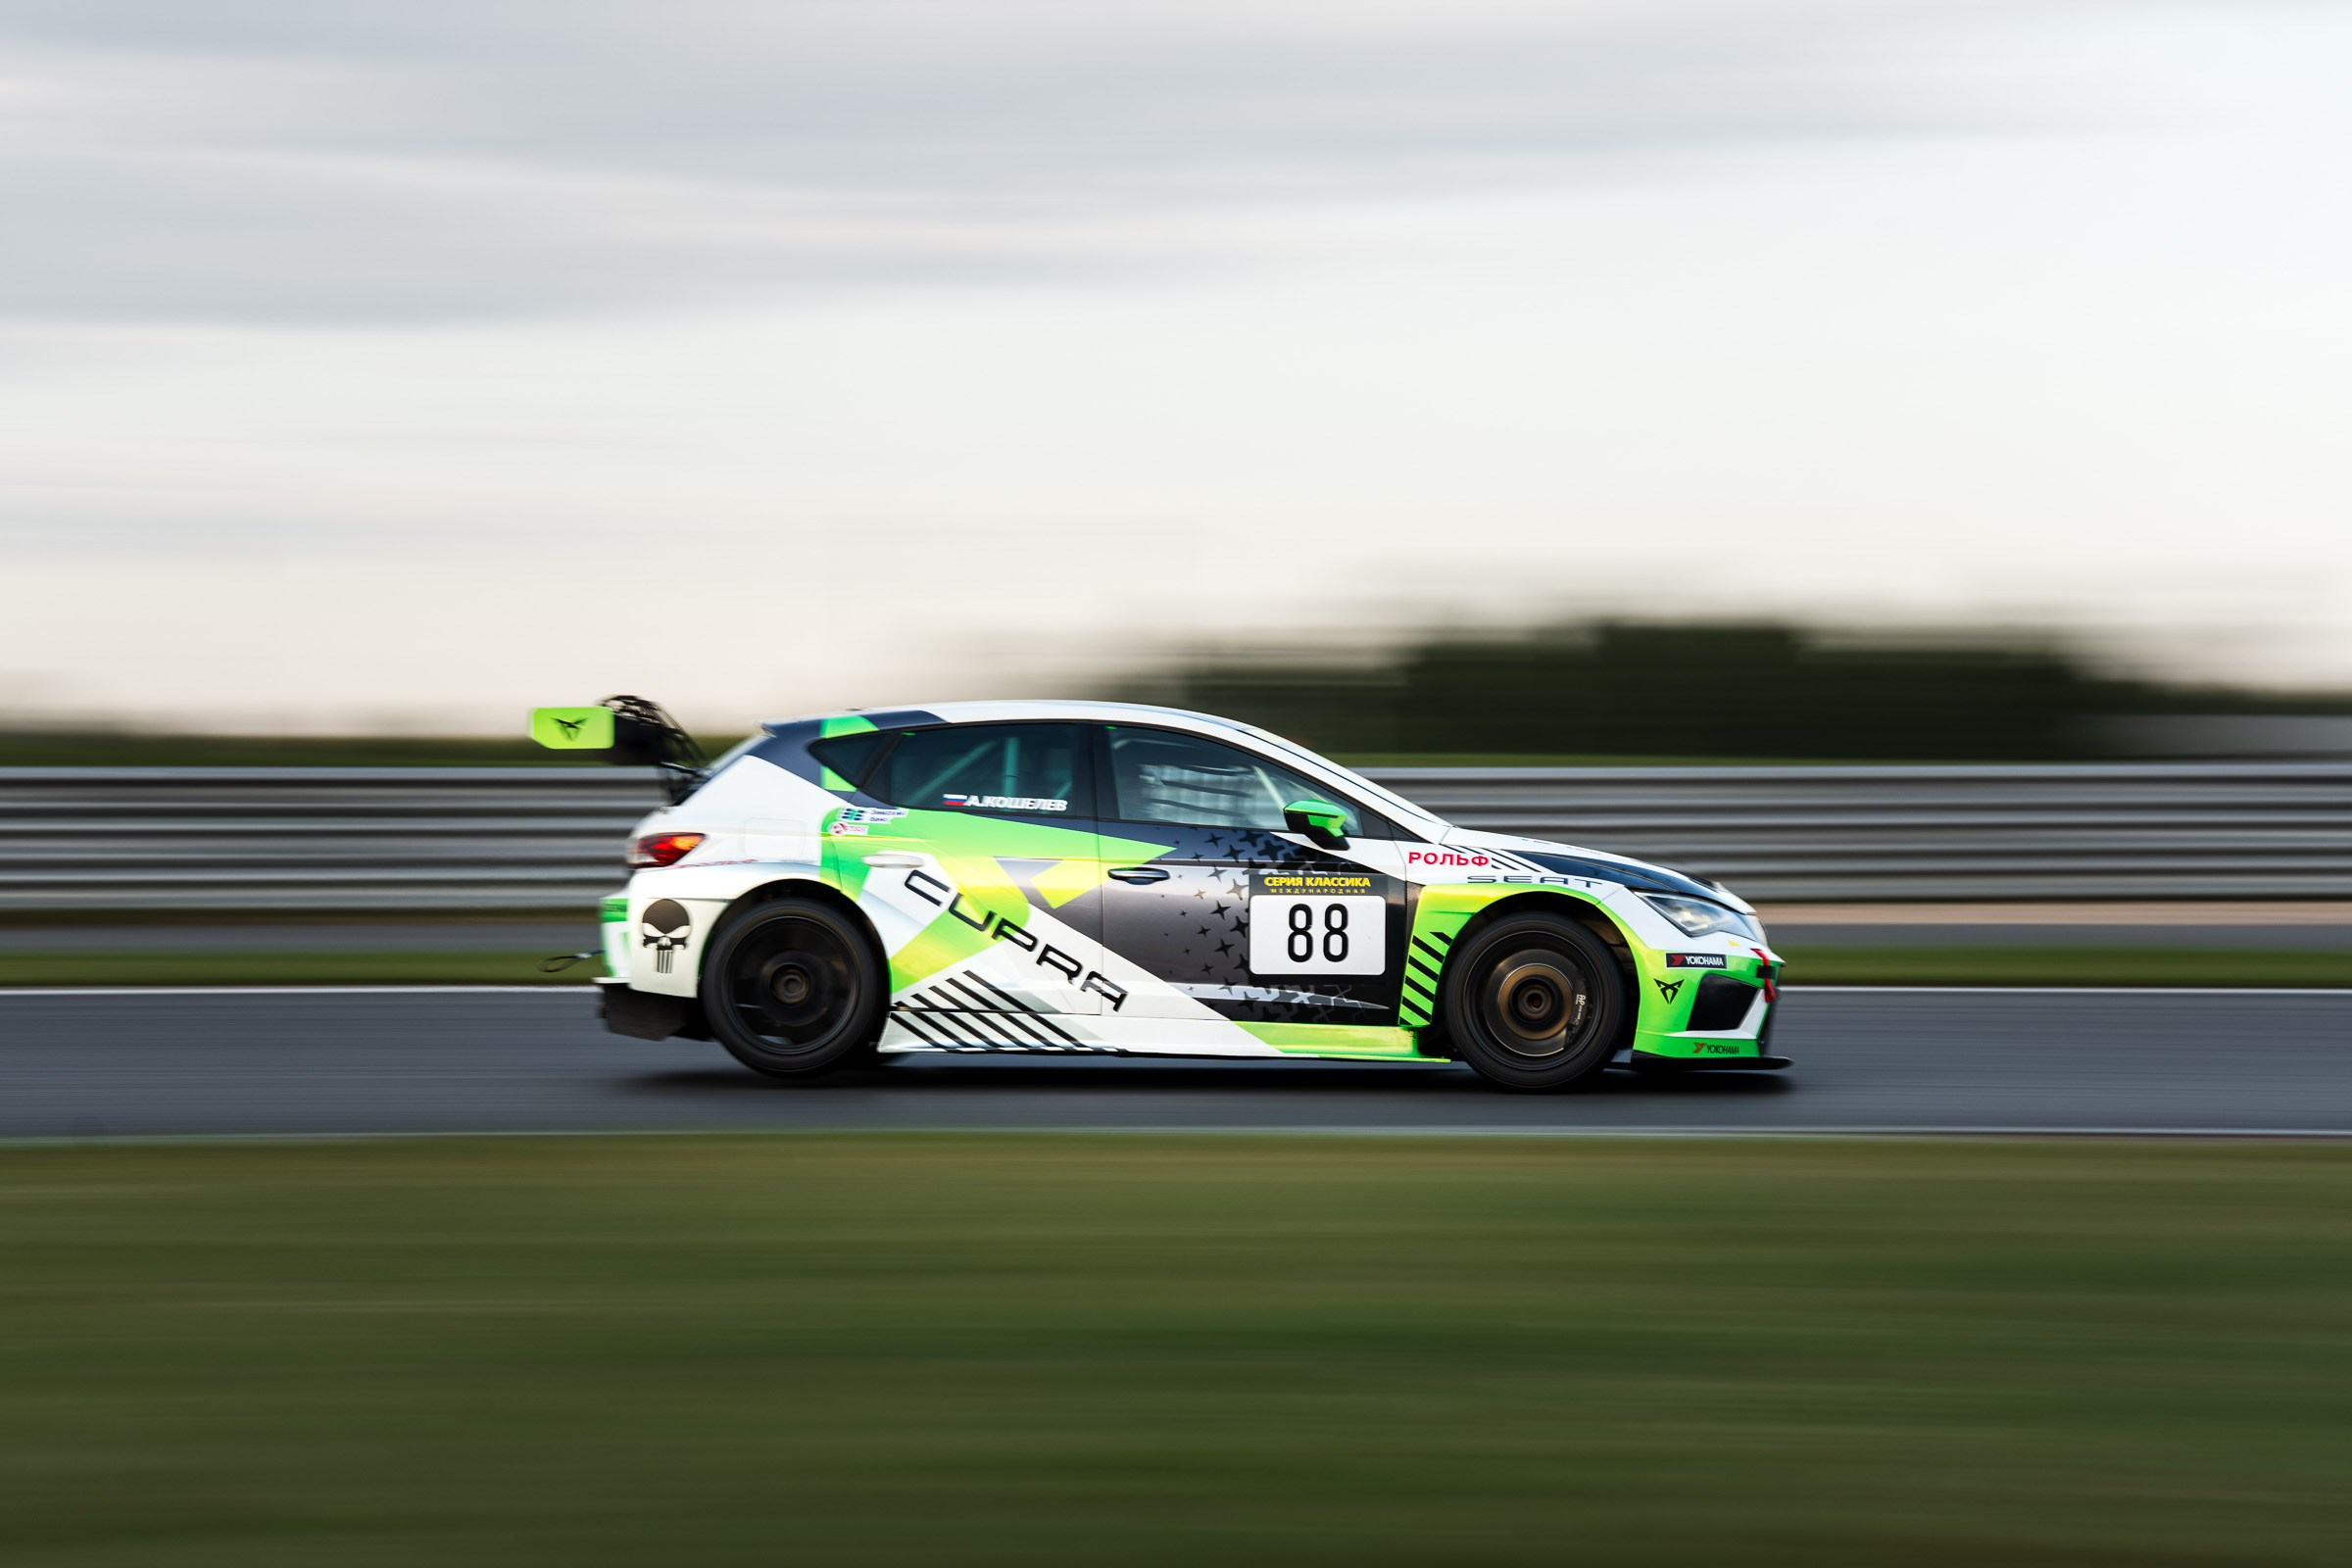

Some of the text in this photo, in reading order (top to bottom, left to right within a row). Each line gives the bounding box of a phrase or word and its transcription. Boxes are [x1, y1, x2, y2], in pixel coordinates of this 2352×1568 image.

[964, 795, 1067, 811] А.КОШЕЛЕВ
[1408, 852, 1490, 867] РОЛЬФ
[1263, 876, 1371, 887] СЕРИЯ КЛАССИКА
[1467, 875, 1602, 889] SEAT
[1288, 903, 1348, 963] 88
[905, 869, 1129, 1012] CUPRA
[1685, 955, 1725, 966] YOKOHAMA
[1706, 1044, 1740, 1054] YOKOHAMA
